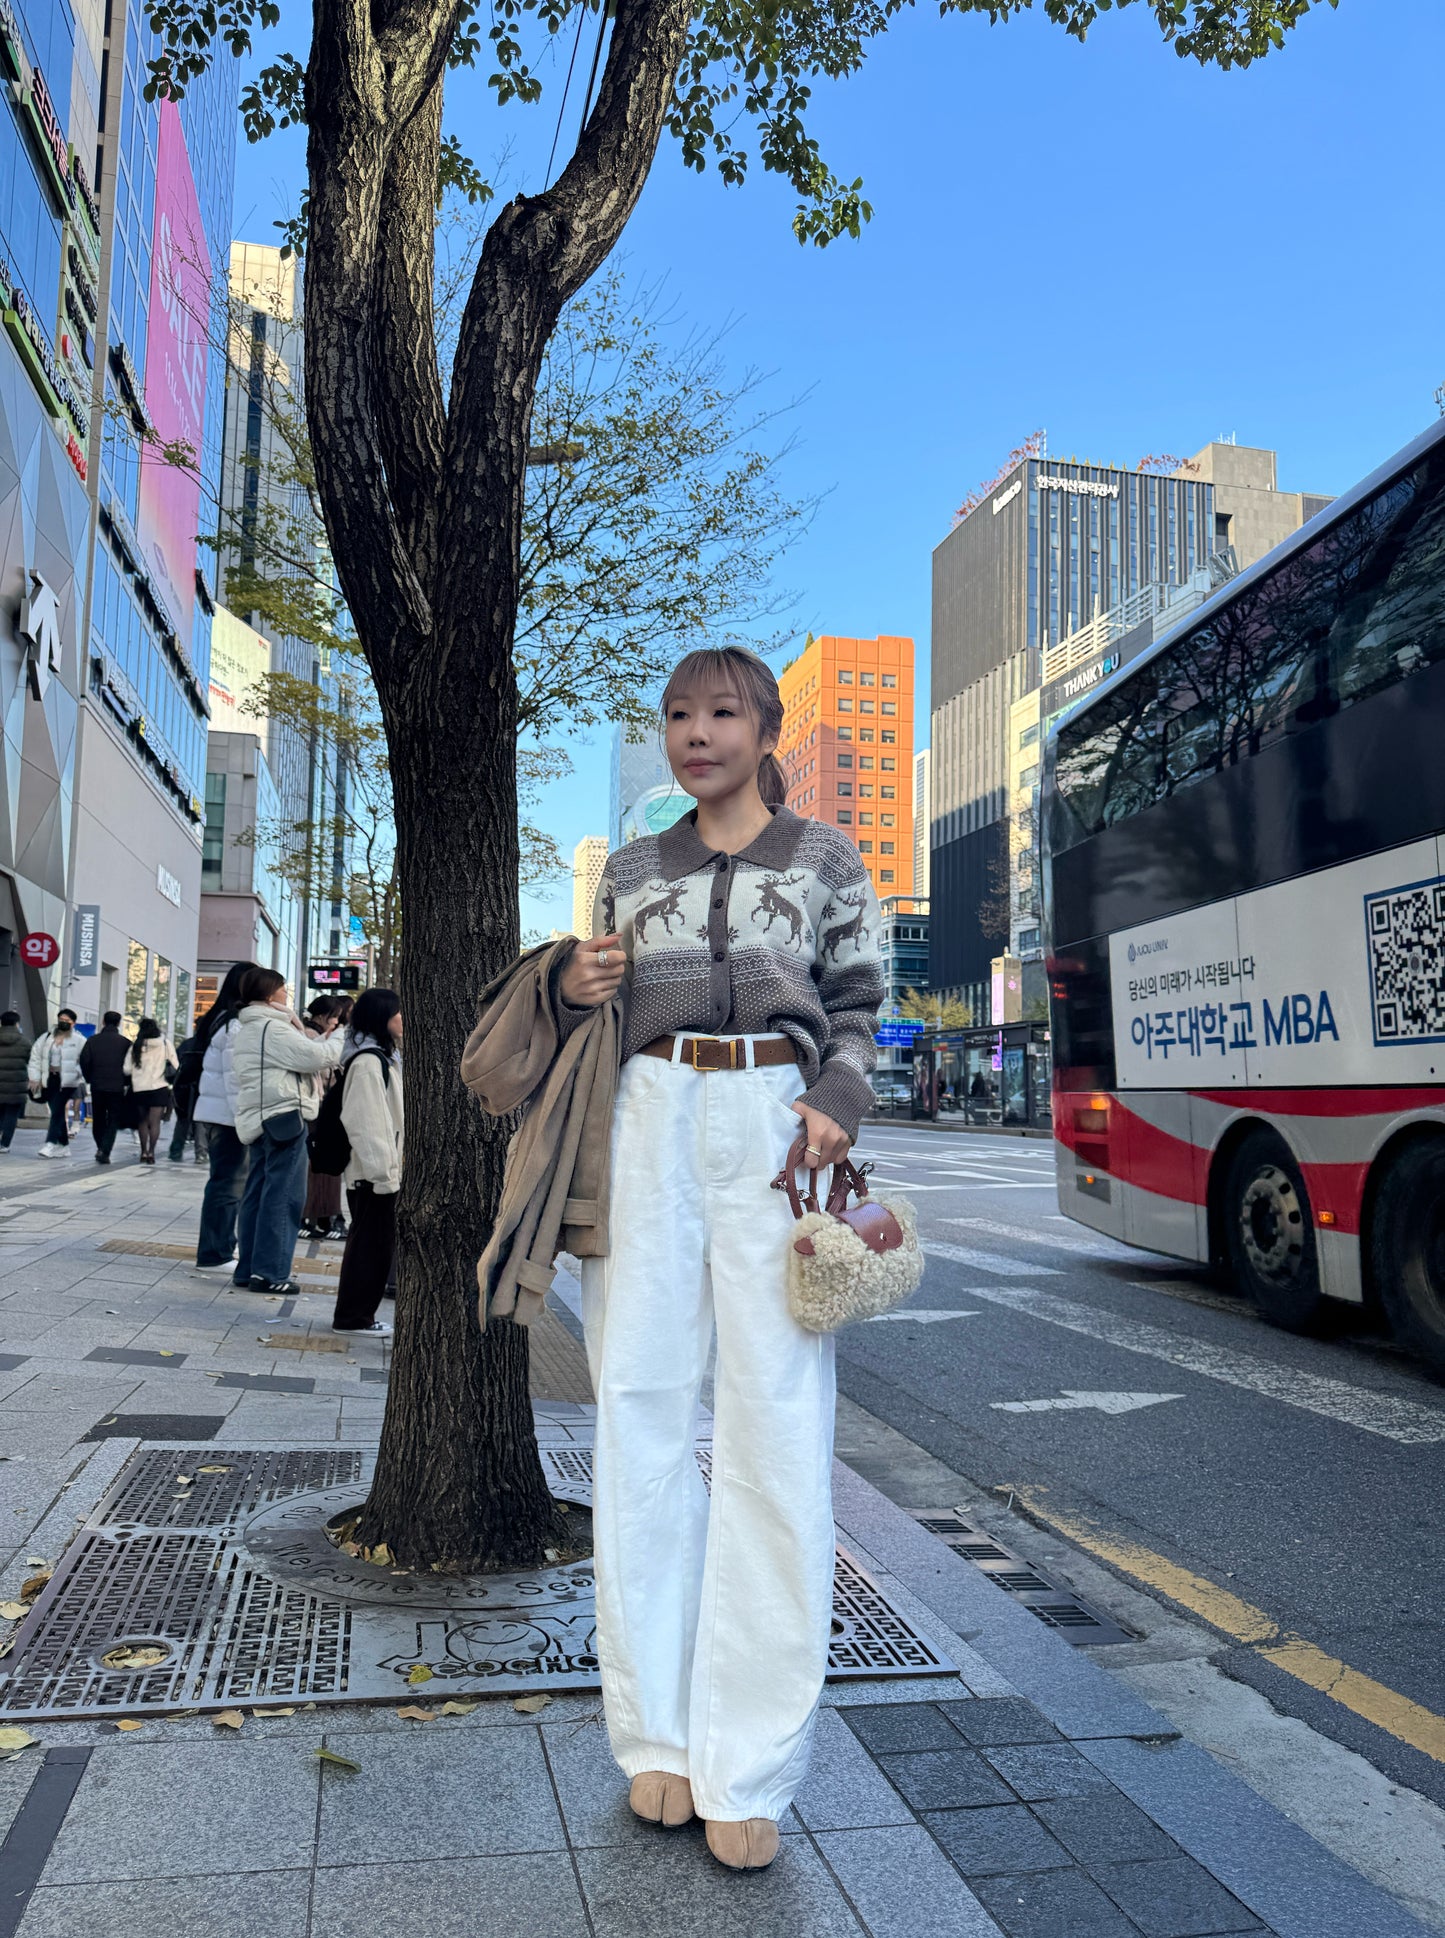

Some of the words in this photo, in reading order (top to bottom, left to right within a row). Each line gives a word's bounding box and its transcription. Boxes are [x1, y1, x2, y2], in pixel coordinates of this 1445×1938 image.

[26, 938, 52, 962] 약
[79, 913, 95, 967] MUSINSA
[1128, 974, 1158, 1002] 당신의
[1160, 968, 1192, 994] 미래가
[1194, 955, 1256, 989] 시작됩니다
[1131, 1002, 1258, 1059] 아주대학교
[1262, 990, 1340, 1047] MBA
[273, 1541, 415, 1596] Welcome
[442, 1585, 489, 1599] to
